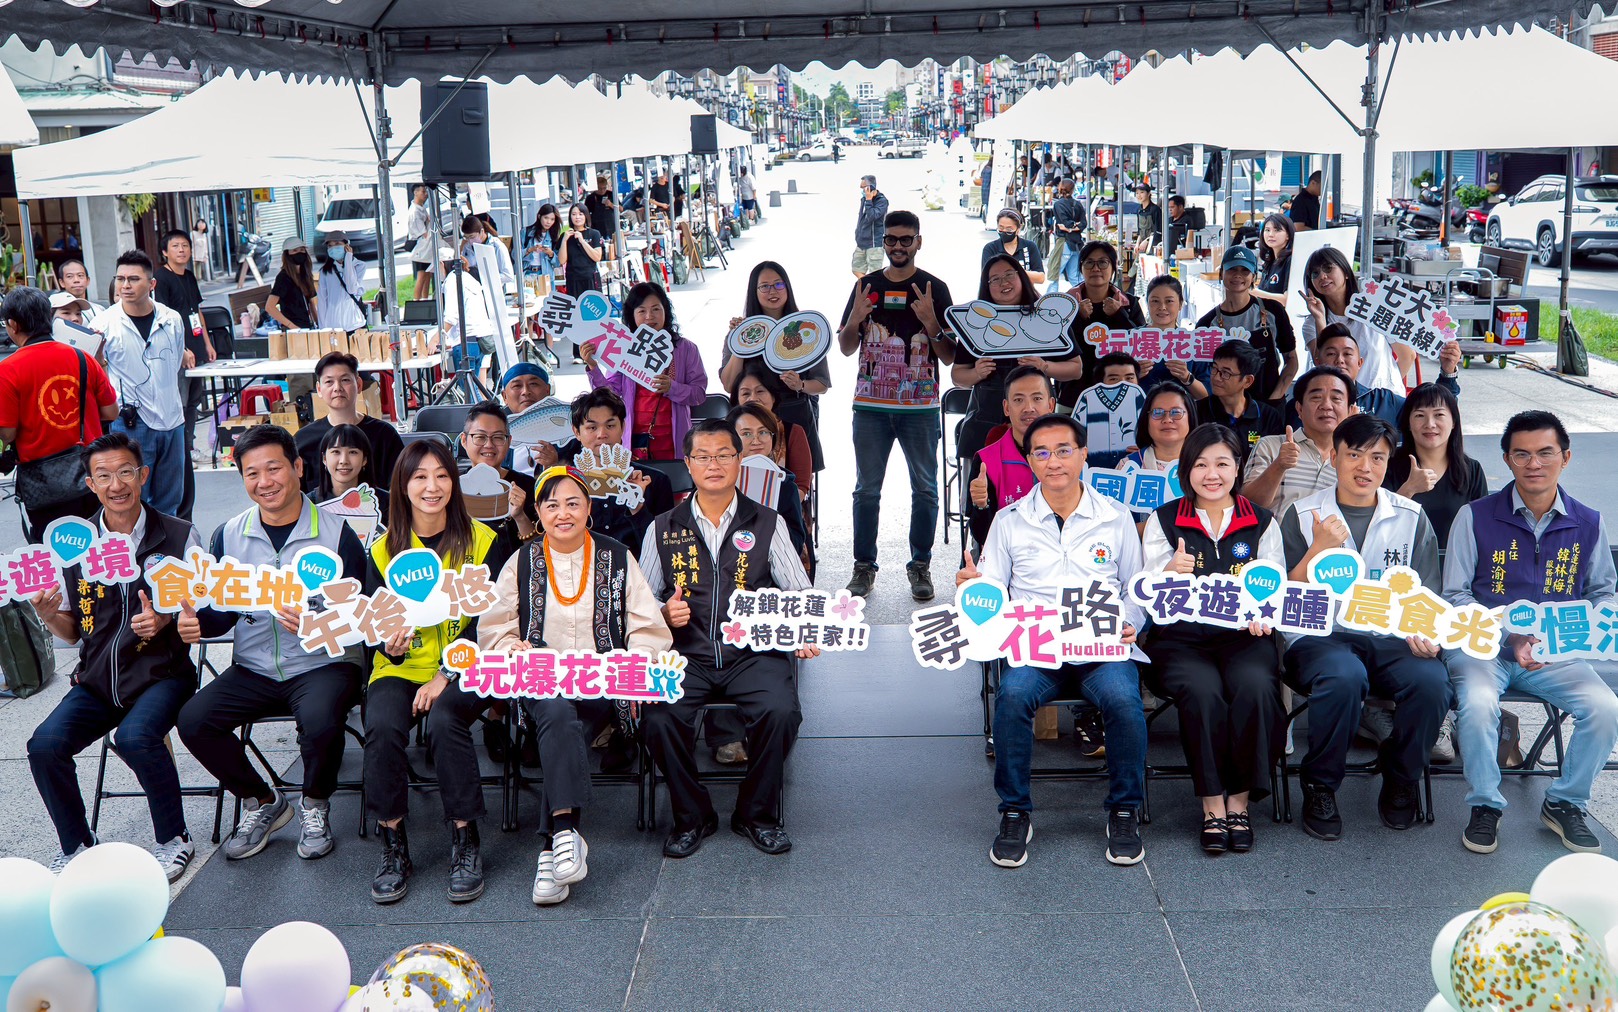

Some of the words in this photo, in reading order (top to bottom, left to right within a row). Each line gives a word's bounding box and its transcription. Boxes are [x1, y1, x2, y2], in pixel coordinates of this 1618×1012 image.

[542, 295, 576, 335] 尋
[583, 297, 602, 318] Way
[1383, 280, 1433, 323] 七大
[1089, 328, 1102, 340] GO!
[1098, 330, 1224, 360] 玩爆花蓮
[1349, 296, 1444, 356] 主題路線!
[0, 551, 59, 600] 遊
[54, 532, 87, 549] Way
[86, 538, 134, 579] 境
[1508, 539, 1519, 561] 主任
[150, 562, 303, 614] 食在地
[301, 559, 331, 580] Way
[732, 593, 827, 618] 解鎖花蓮
[1151, 577, 1241, 622] 夜遊
[1248, 575, 1277, 590] Way
[1281, 587, 1330, 630] 醺
[302, 591, 411, 655] 午後
[392, 565, 434, 588] Way
[441, 567, 497, 617] 悠
[915, 609, 970, 665] 尋
[965, 593, 998, 612] Way
[1317, 565, 1354, 580] Way
[1343, 584, 1495, 654] 晨食光
[1511, 611, 1533, 623] CHILL!
[750, 623, 865, 647] 特色店家!!
[1062, 643, 1125, 656] Hualien
[452, 649, 470, 665] GO!
[463, 653, 665, 697] 玩爆花蓮
